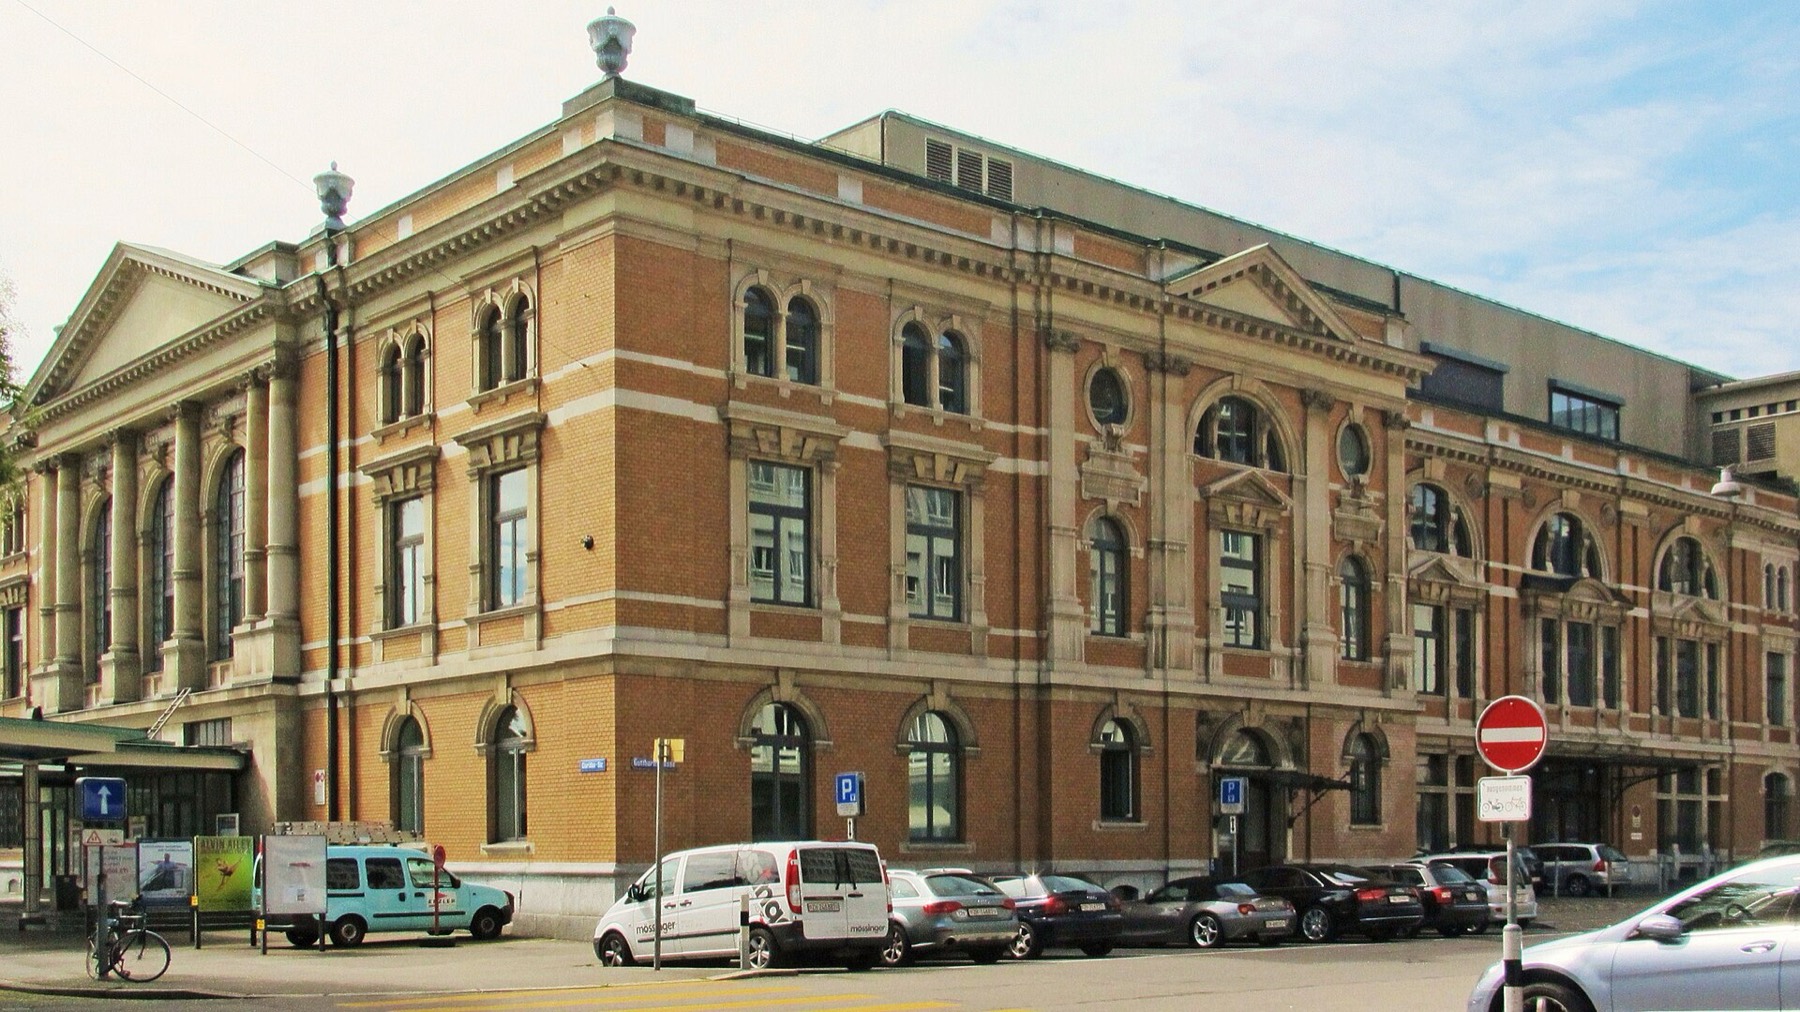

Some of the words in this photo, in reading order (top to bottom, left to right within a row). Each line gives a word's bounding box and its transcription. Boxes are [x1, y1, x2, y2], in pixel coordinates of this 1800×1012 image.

[633, 757, 676, 768] Gotthardasse
[842, 779, 852, 800] P
[1228, 782, 1235, 793] P
[636, 921, 676, 934] mössger
